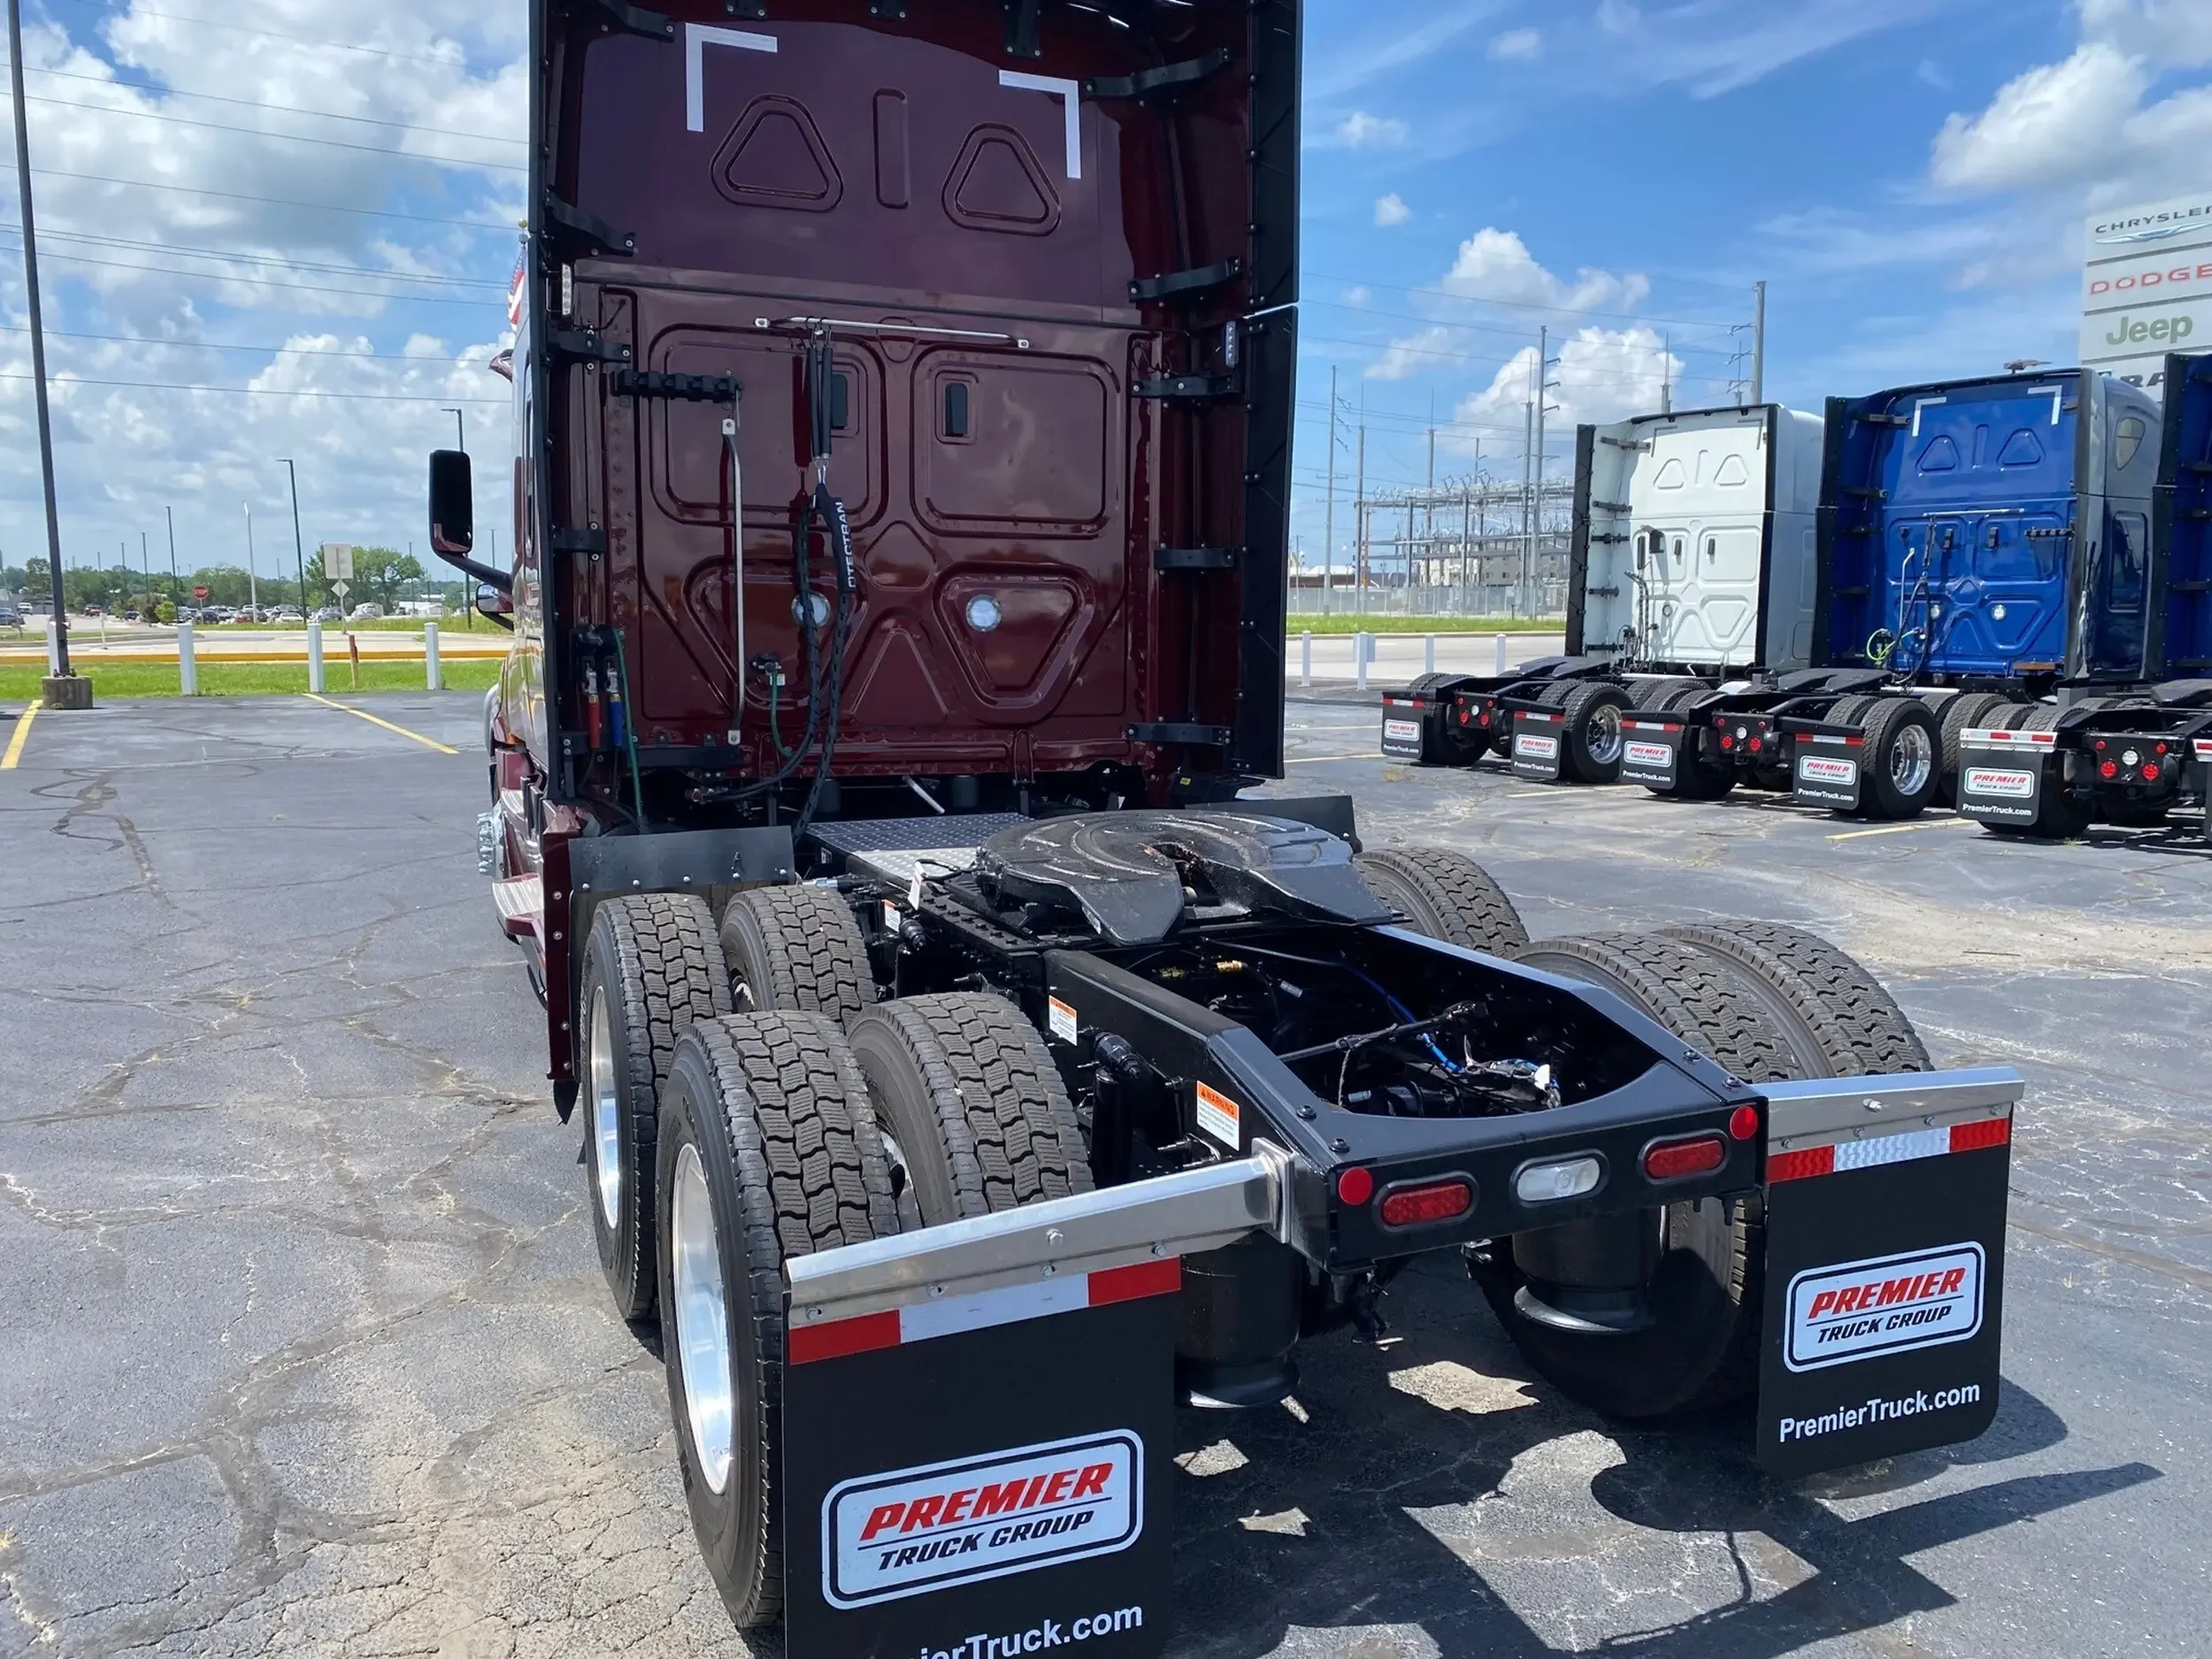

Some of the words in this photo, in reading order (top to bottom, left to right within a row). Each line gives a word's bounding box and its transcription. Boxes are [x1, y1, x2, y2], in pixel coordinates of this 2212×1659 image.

[2090, 263, 2212, 296] DODGE
[2106, 315, 2193, 346] Jeep
[835, 502, 854, 577] TECTRAN
[1514, 761, 1555, 772] PremierTruck.com
[1629, 746, 1667, 756] PREMIER
[1806, 762, 1850, 772] PREMIER
[1623, 769, 1671, 782] PremierTruck.com
[1973, 774, 2026, 783] PREMIER
[1797, 787, 1855, 802] PremierTruck.com
[1962, 803, 2032, 816] PremierTruck.com
[1808, 1267, 1967, 1320] PREMIER
[1817, 1317, 1885, 1344] TRUCK
[1886, 1305, 1953, 1330] GROUP
[1779, 1383, 1981, 1443] PremierTruck.com
[859, 1461, 1115, 1542] PREMIER
[879, 1532, 985, 1571] TRUCK
[988, 1509, 1095, 1548] GROUP
[911, 1605, 1143, 1659] rTruck.com
